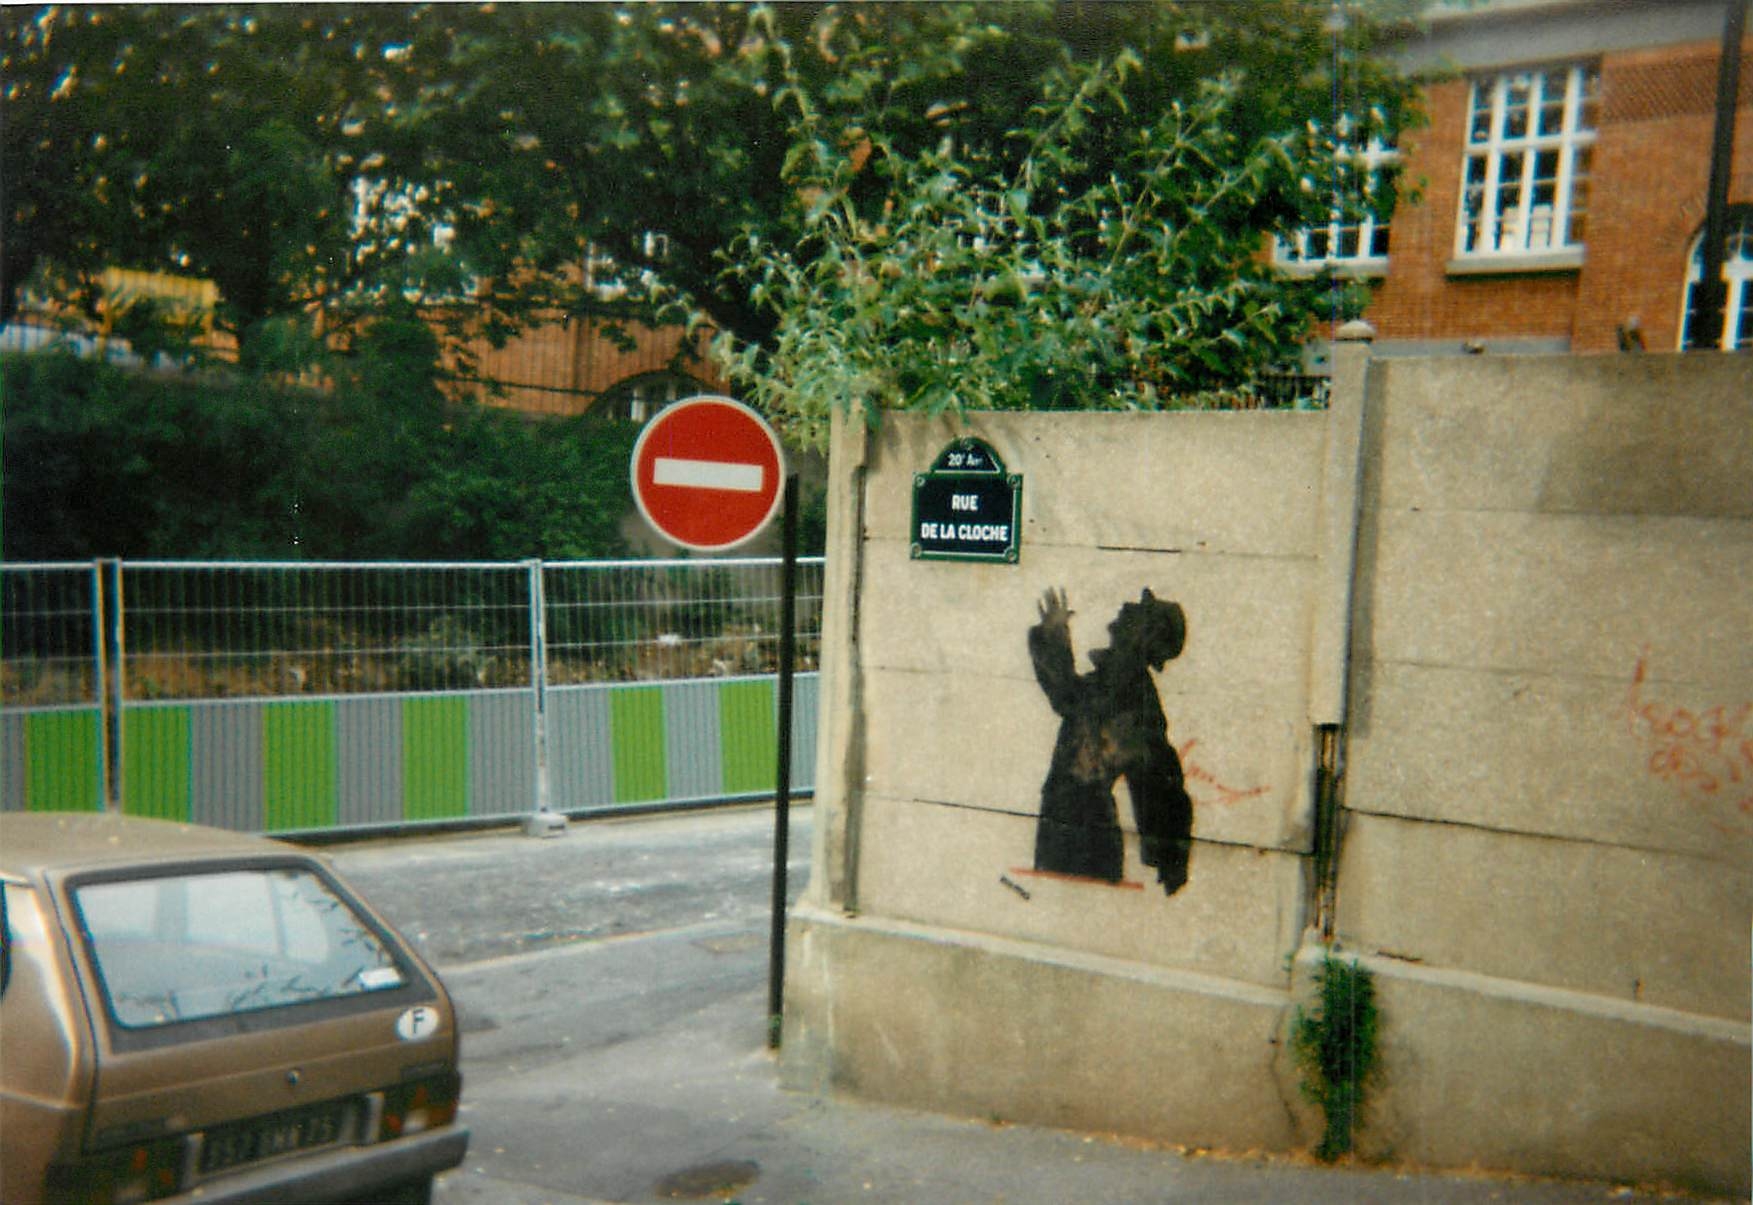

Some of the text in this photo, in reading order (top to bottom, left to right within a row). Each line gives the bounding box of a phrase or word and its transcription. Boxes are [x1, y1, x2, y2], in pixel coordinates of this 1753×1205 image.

[952, 494, 979, 511] RUE
[921, 523, 1009, 541] DE LA CLOCHE
[412, 1008, 425, 1035] F
